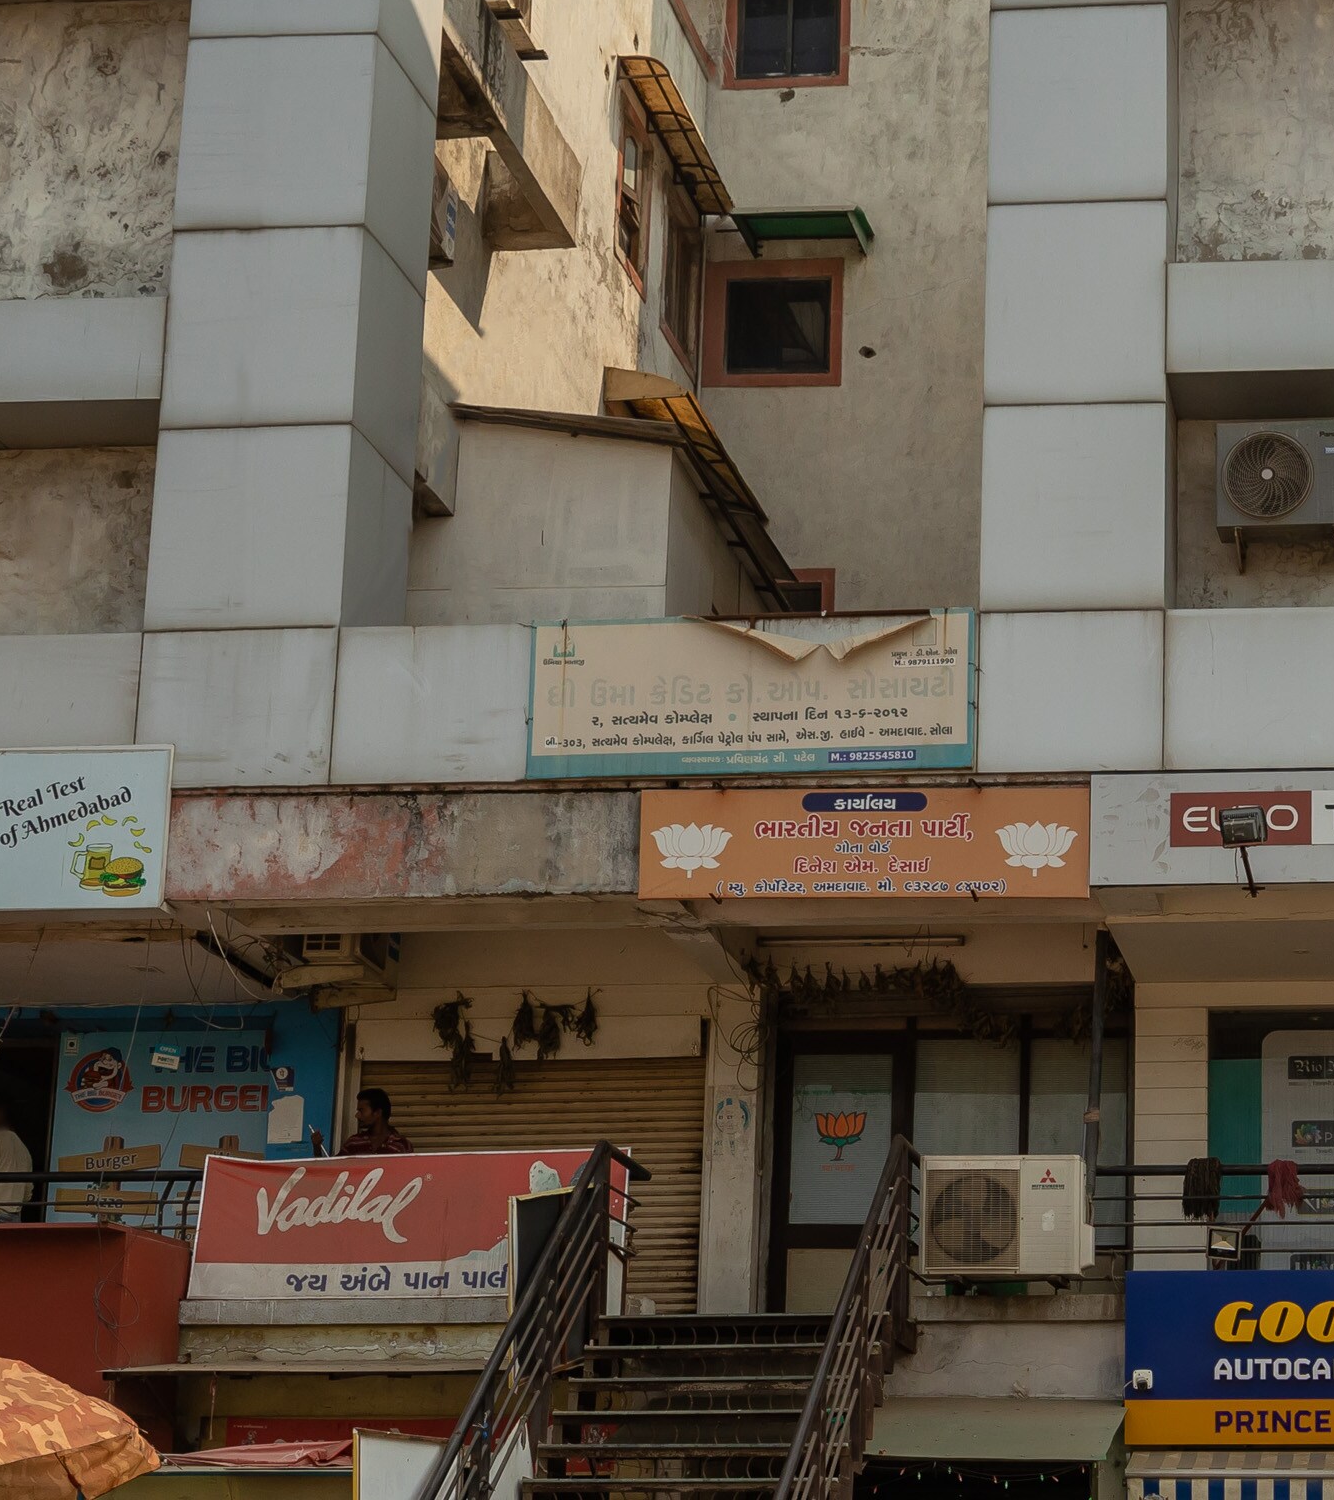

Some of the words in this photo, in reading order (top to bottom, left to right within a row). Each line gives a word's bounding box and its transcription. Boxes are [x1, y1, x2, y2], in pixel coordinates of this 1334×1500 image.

[908, 657, 955, 666] 9879111990
[850, 750, 915, 762] 9825545810
[46, 775, 87, 801] Test
[0, 823, 19, 849] of
[21, 786, 133, 841] Ahmedabad
[754, 814, 840, 839] ભારતીય
[849, 818, 912, 838] જનતા
[1182, 804, 1299, 833] EO
[793, 856, 837, 875] દિનેશ
[85, 1151, 138, 1171] Burger
[257, 1166, 423, 1244] Vadilal
[286, 1271, 327, 1293] જય
[404, 1271, 449, 1290] પાન
[1214, 1410, 1332, 1434] PRINCE
